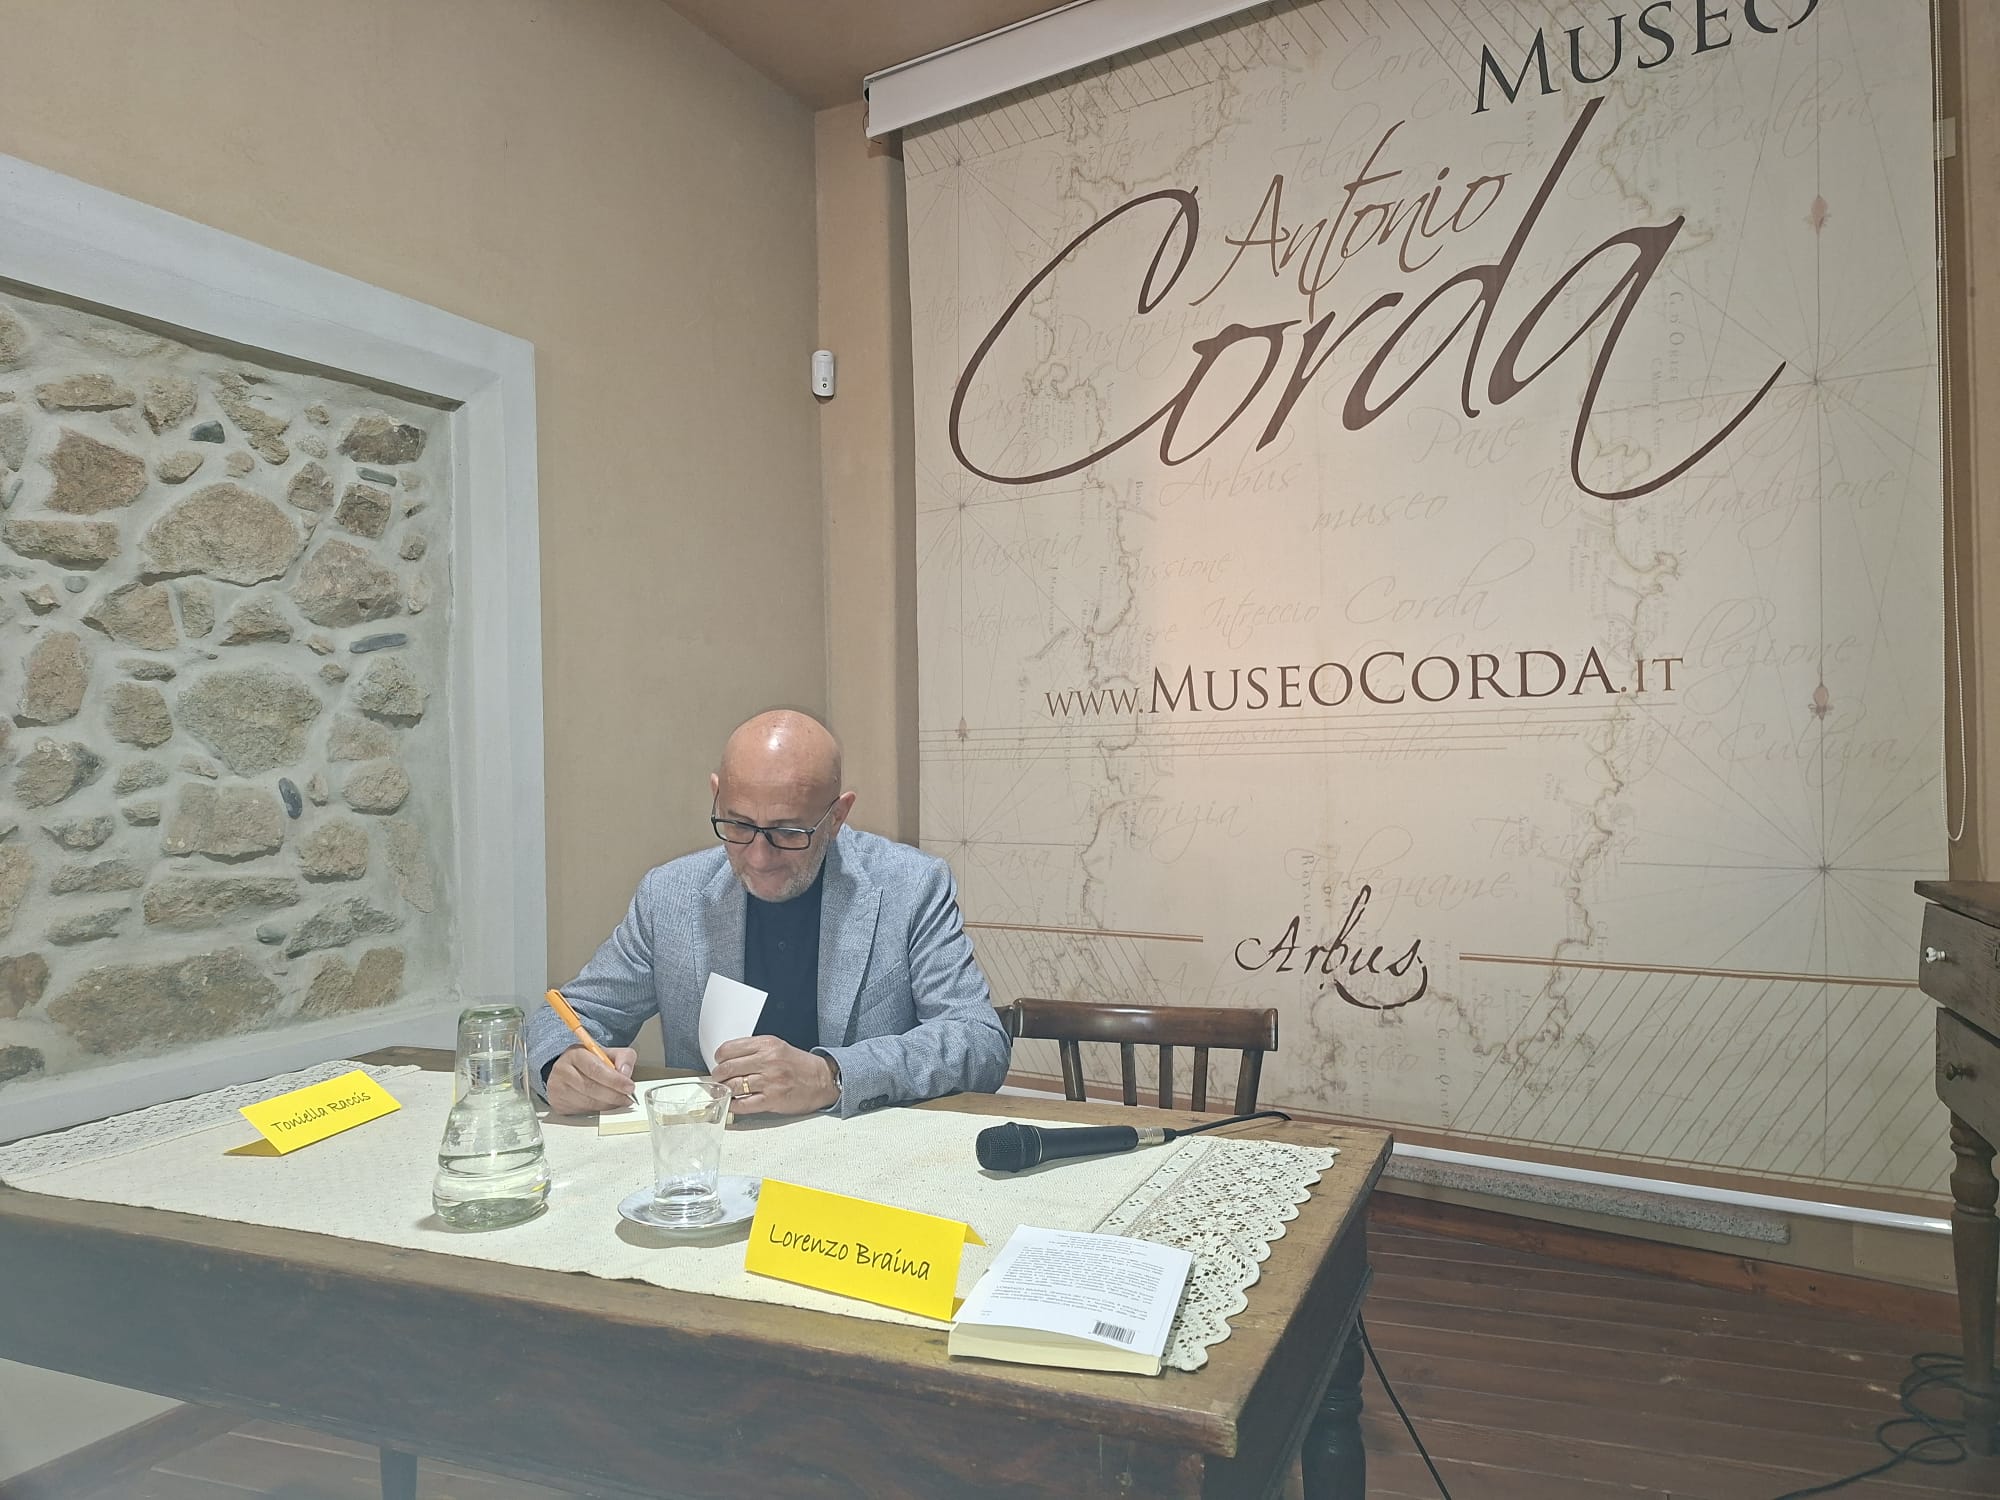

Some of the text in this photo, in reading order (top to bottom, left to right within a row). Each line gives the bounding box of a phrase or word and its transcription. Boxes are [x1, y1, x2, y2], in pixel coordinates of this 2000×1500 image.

[1190, 120, 1512, 324] Antonio
[949, 97, 1786, 499] Corda
[1234, 884, 1428, 1011] Arbus
[270, 1106, 329, 1133] Toniella
[769, 1223, 932, 1281] Lorenzo Braina
